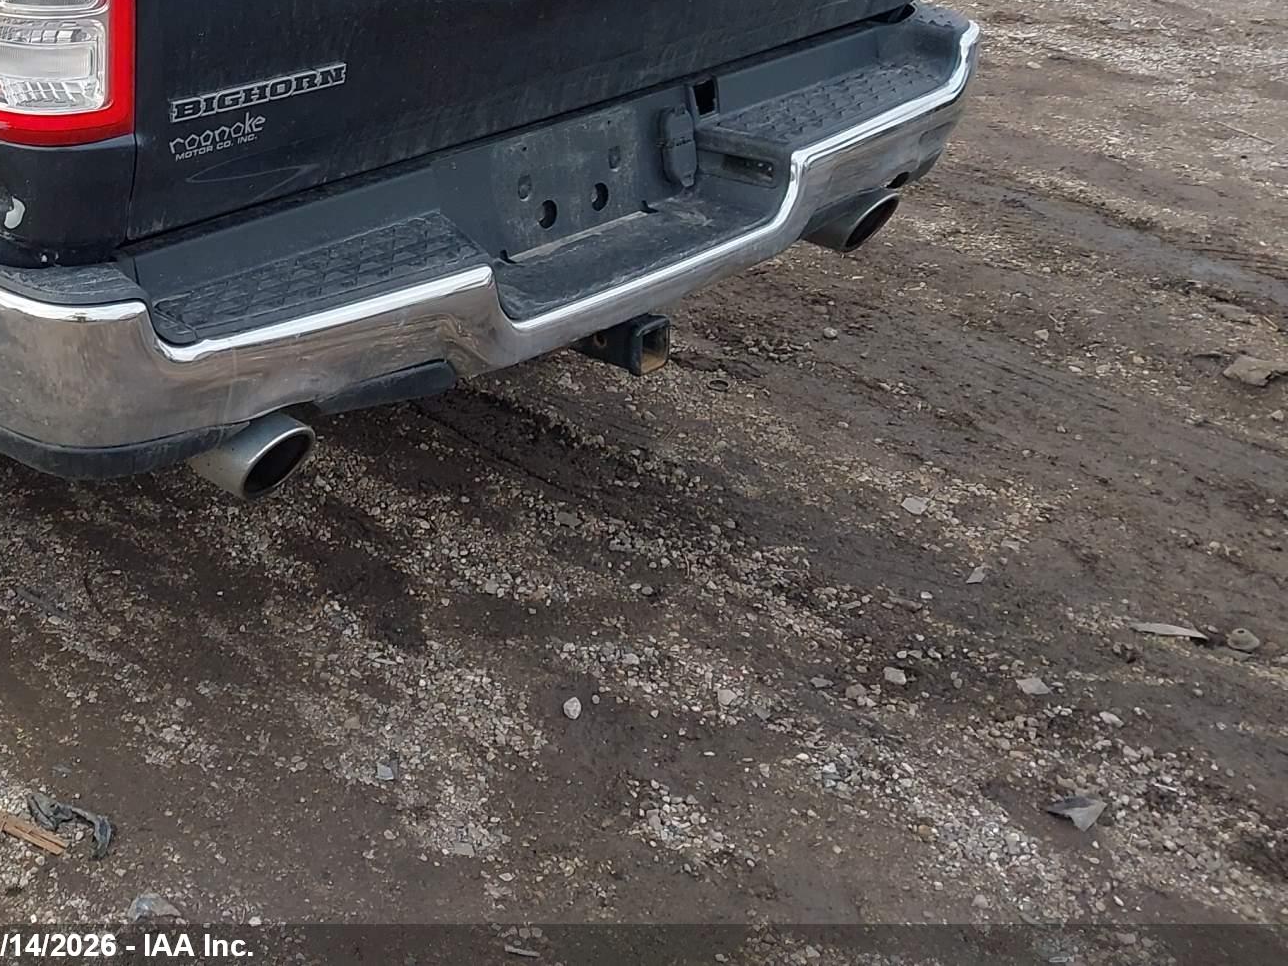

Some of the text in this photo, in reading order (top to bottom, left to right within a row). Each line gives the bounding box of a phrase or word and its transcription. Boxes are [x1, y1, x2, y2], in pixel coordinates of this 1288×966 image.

[170, 63, 347, 122] BIGHORN
[175, 145, 213, 162] MOTOR
[237, 134, 258, 145] INC.
